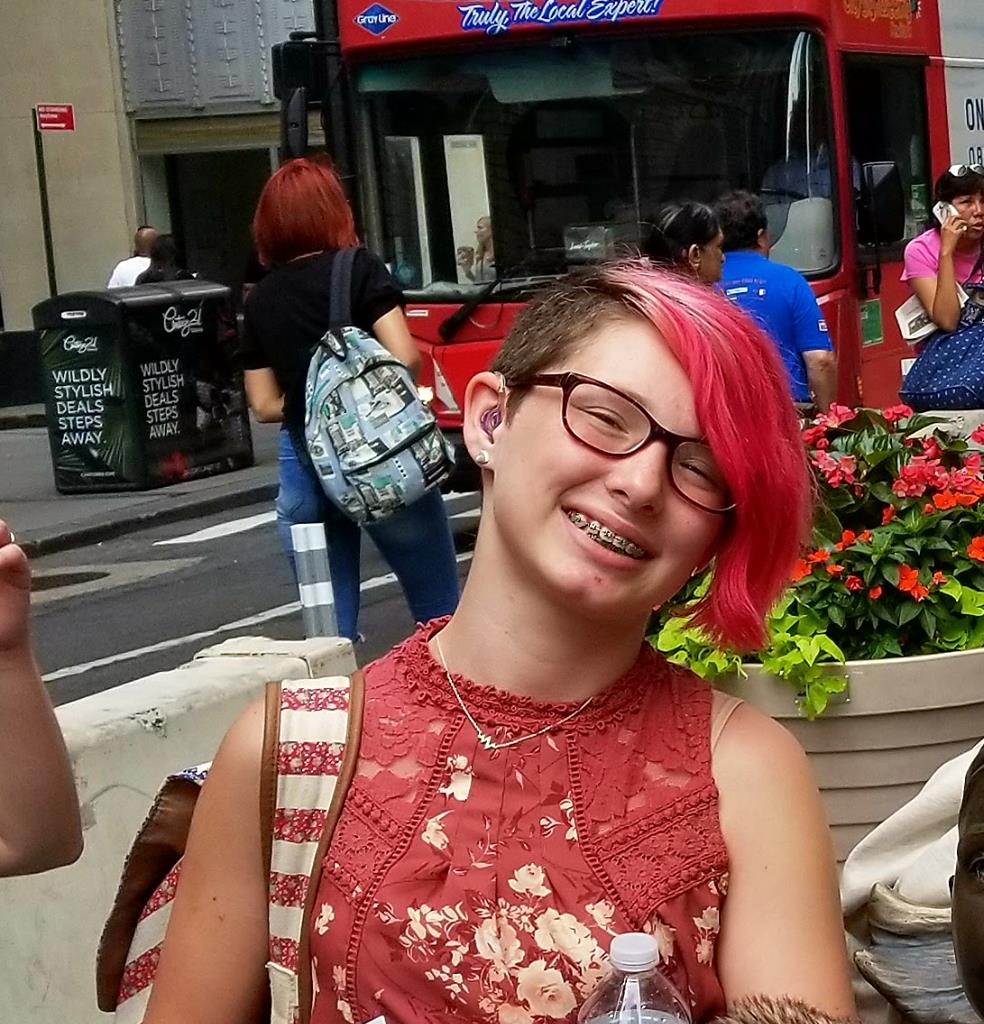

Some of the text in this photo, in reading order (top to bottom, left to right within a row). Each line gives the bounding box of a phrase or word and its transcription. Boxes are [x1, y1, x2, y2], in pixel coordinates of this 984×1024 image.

[510, 1, 539, 21] The
[537, 0, 585, 23] Local
[586, 0, 660, 22] Expert!
[51, 367, 108, 384] WILDLY
[140, 358, 180, 378] WILDLY
[54, 382, 114, 399] STYLISH
[142, 374, 185, 394] STYLISH
[56, 399, 105, 415] DEALS
[144, 389, 180, 409] DEALS
[58, 415, 103, 430] STEPS
[146, 405, 179, 425] STEPS
[61, 431, 107, 446] AWAY.
[149, 421, 181, 440] AWAY.
